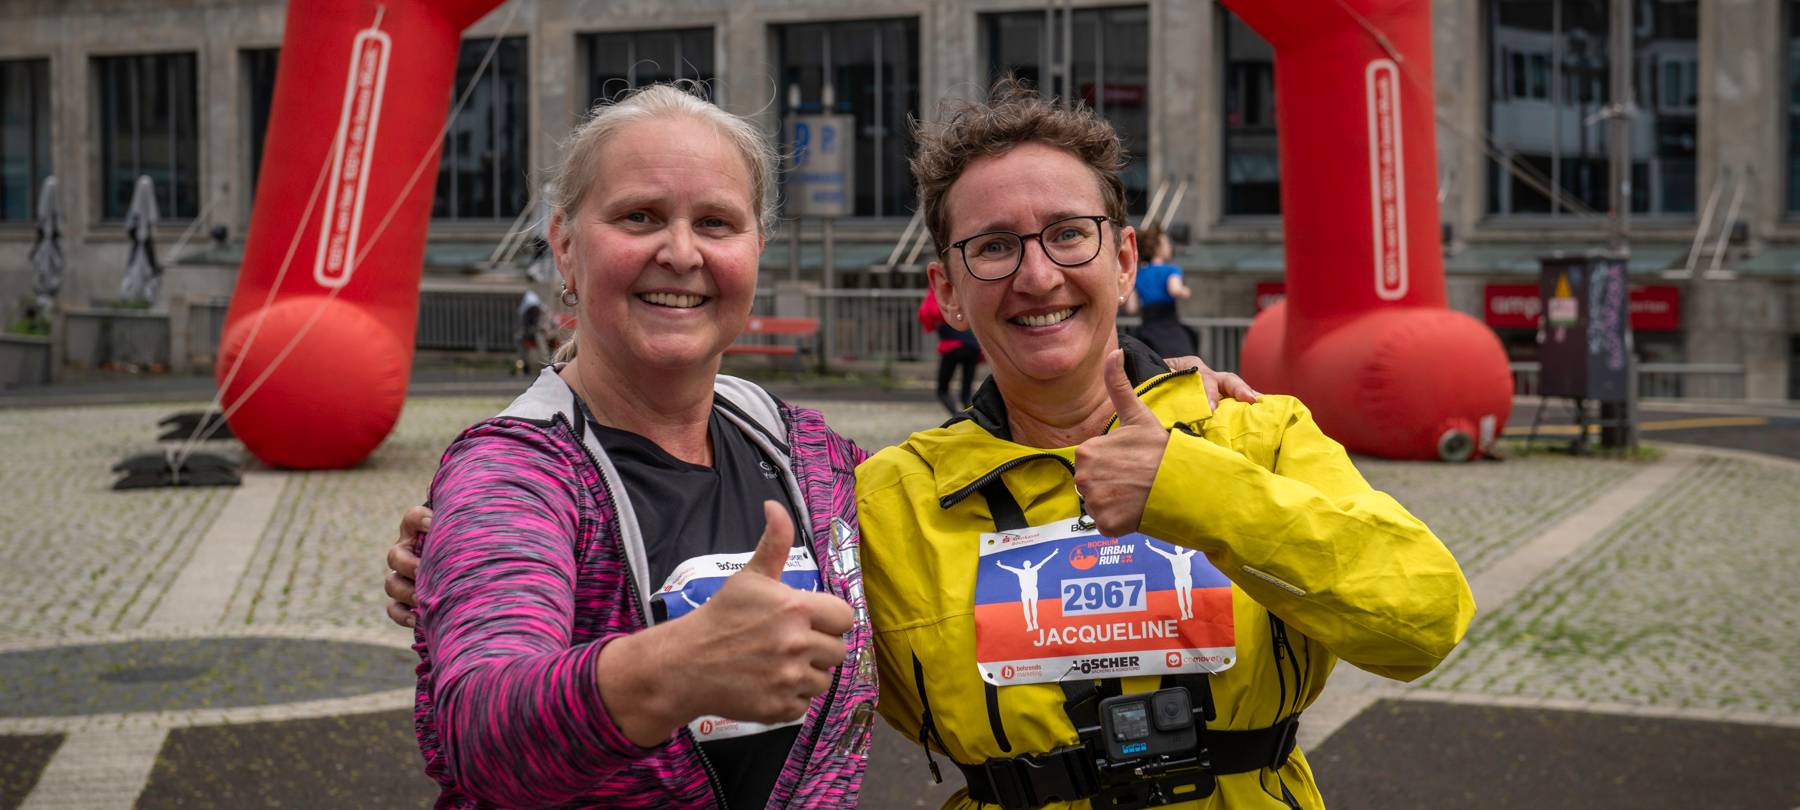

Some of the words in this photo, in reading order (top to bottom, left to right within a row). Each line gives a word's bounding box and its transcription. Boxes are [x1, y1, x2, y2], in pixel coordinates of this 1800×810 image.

[1088, 538, 1119, 549] BOCHUM
[1100, 544, 1135, 556] URBAN
[1099, 555, 1120, 565] RUN
[1064, 580, 1143, 611] 2967
[1033, 620, 1179, 647] JACQUELINE
[1073, 656, 1140, 674] LÖSCHER
